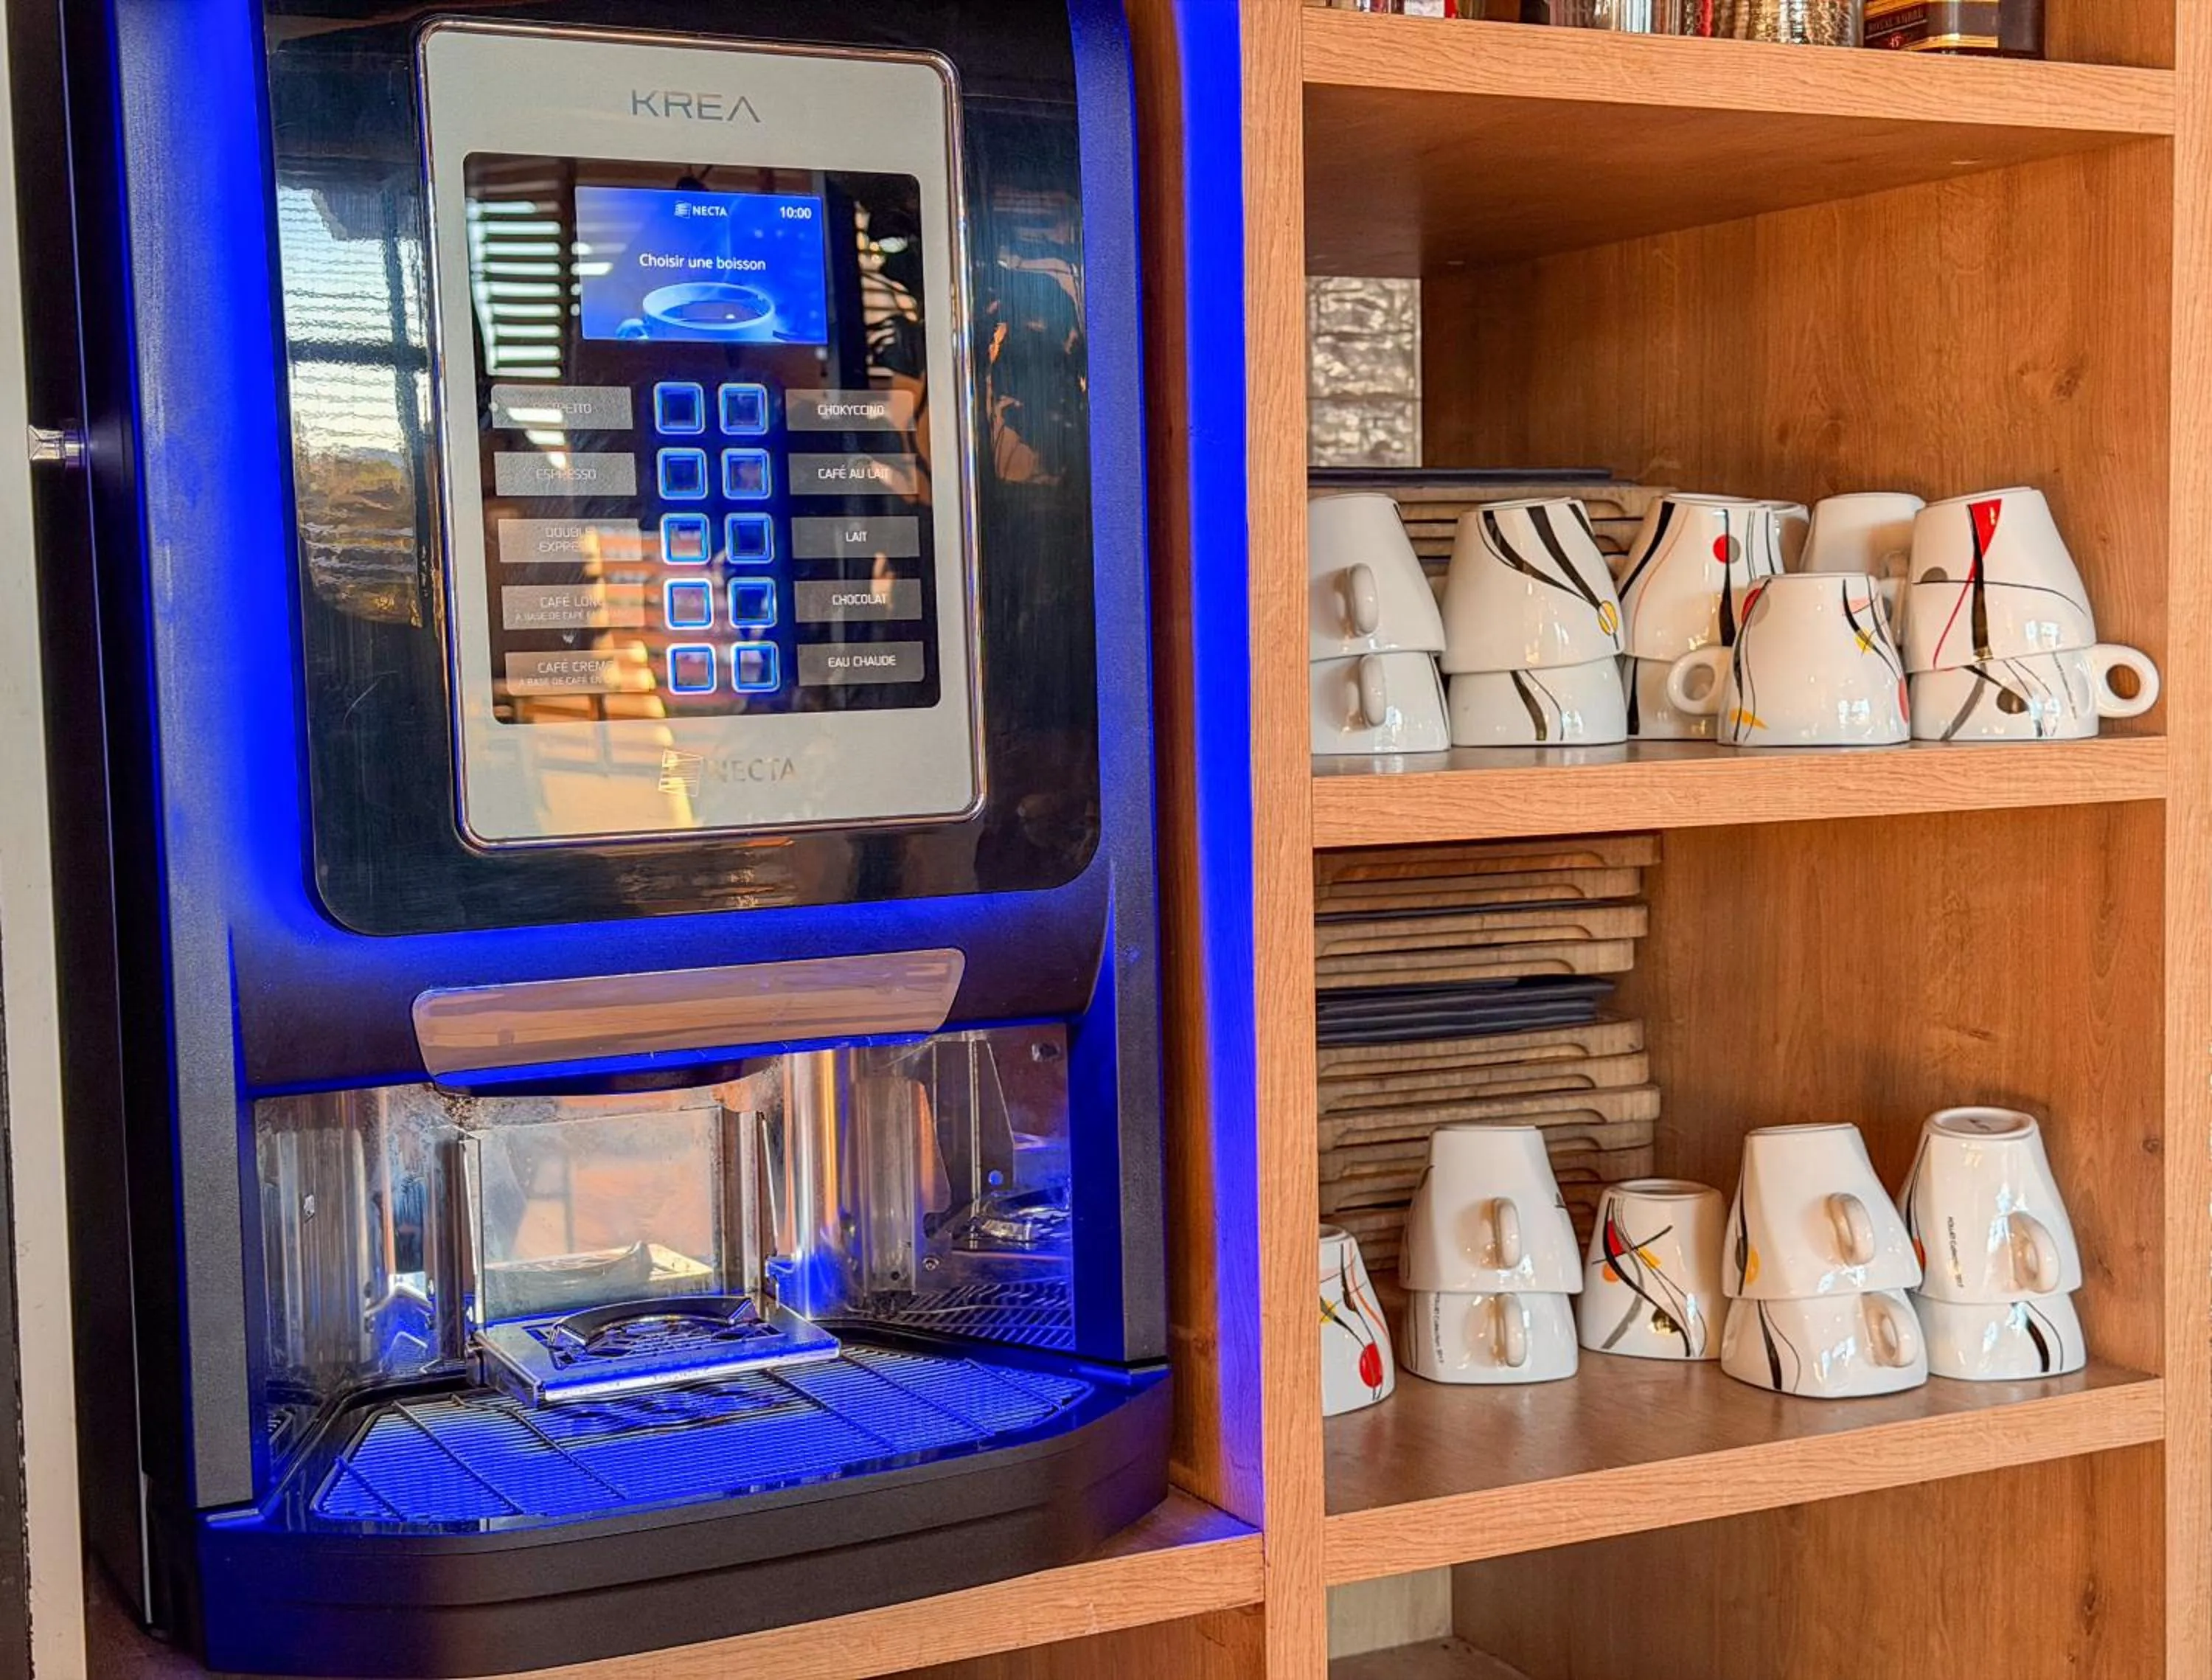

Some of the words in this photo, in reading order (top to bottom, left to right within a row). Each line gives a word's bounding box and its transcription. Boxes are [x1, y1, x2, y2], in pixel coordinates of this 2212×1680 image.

[632, 89, 761, 123] KREA
[692, 205, 728, 217] NECTA
[779, 206, 813, 219] 10:00
[639, 252, 684, 268] Choisir
[688, 257, 714, 269] une
[716, 256, 766, 271] boisson
[817, 465, 846, 479] CAFÉ
[849, 468, 865, 479] AU
[867, 468, 890, 479] LAIT
[845, 531, 869, 543] LAIT
[540, 593, 571, 608] CAFÉ
[832, 593, 886, 606] CHOCOLAT
[538, 658, 569, 673] CAFÉ
[827, 657, 850, 668] EAU
[853, 654, 897, 667] CHAUDE
